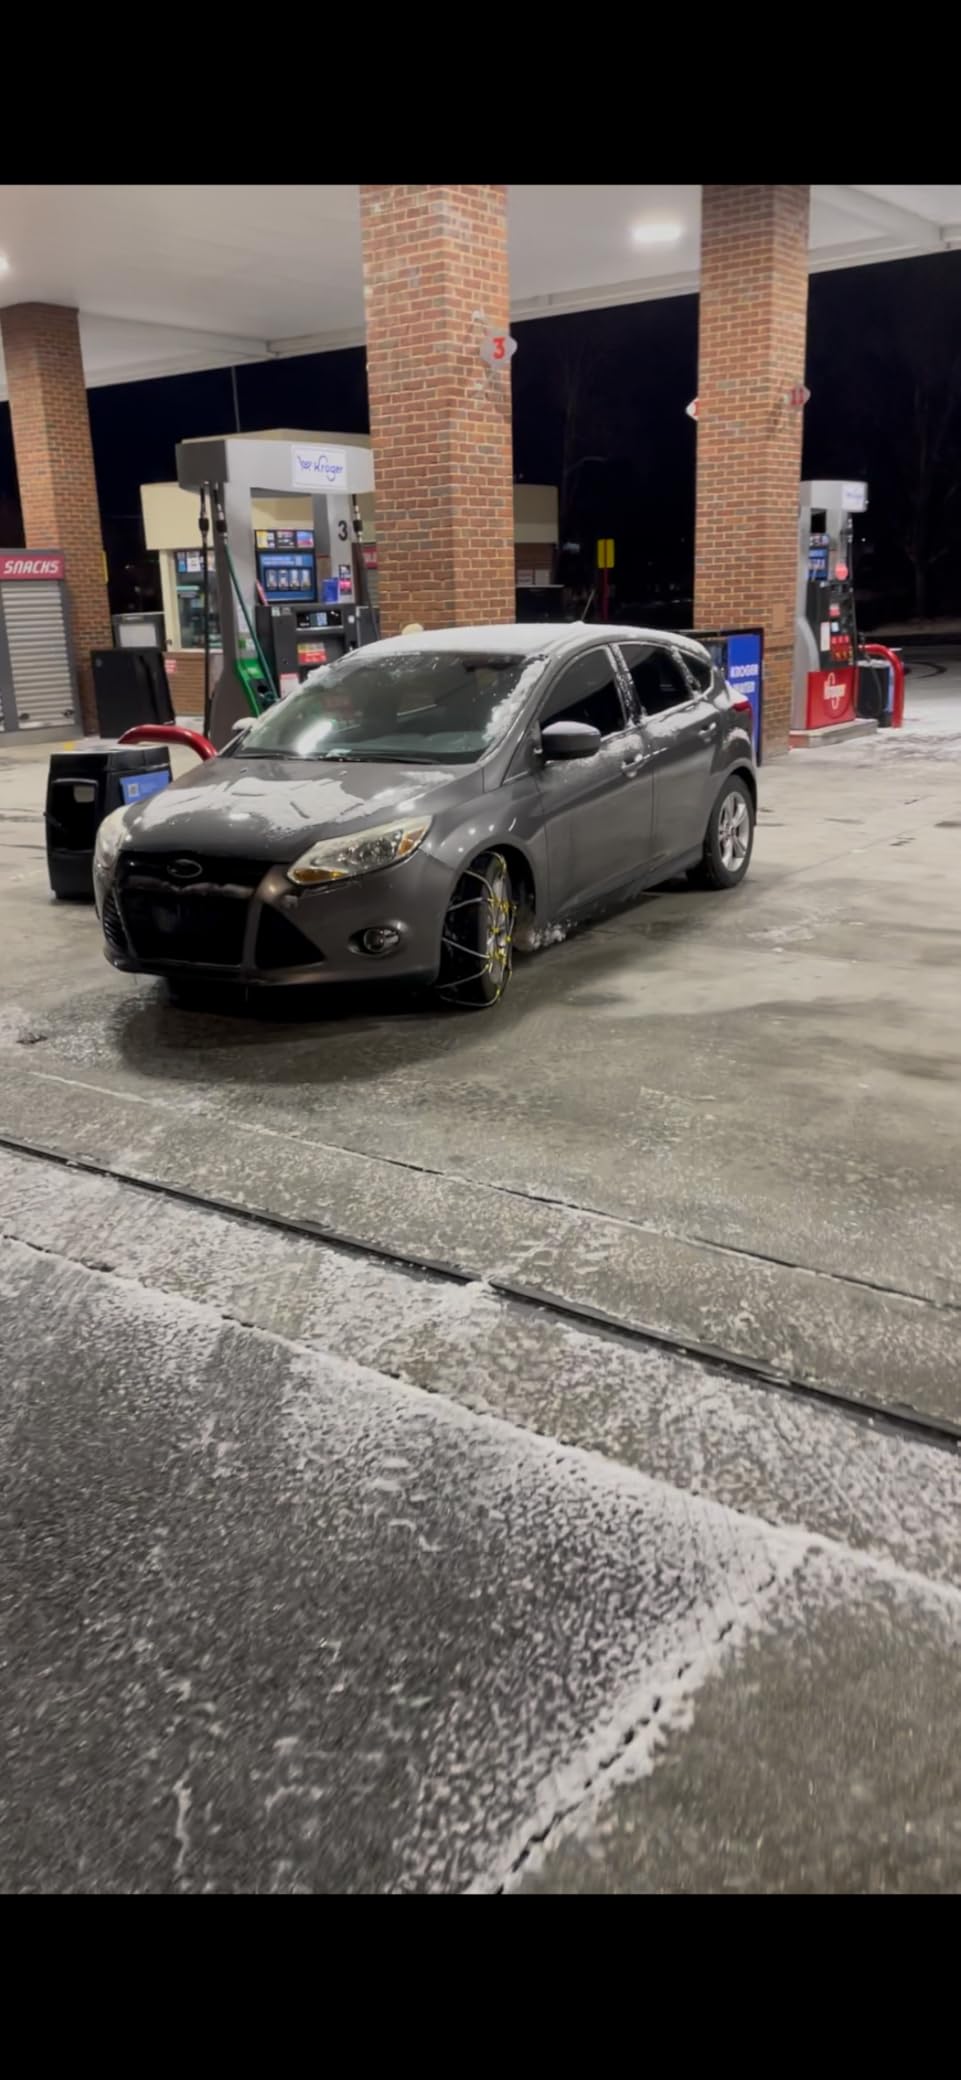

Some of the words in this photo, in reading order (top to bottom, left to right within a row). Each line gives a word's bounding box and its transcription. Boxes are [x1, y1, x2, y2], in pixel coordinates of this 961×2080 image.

[492, 336, 505, 359] 3
[314, 455, 344, 481] Kroger
[338, 520, 348, 541] 3
[3, 560, 60, 574] SNACKS
